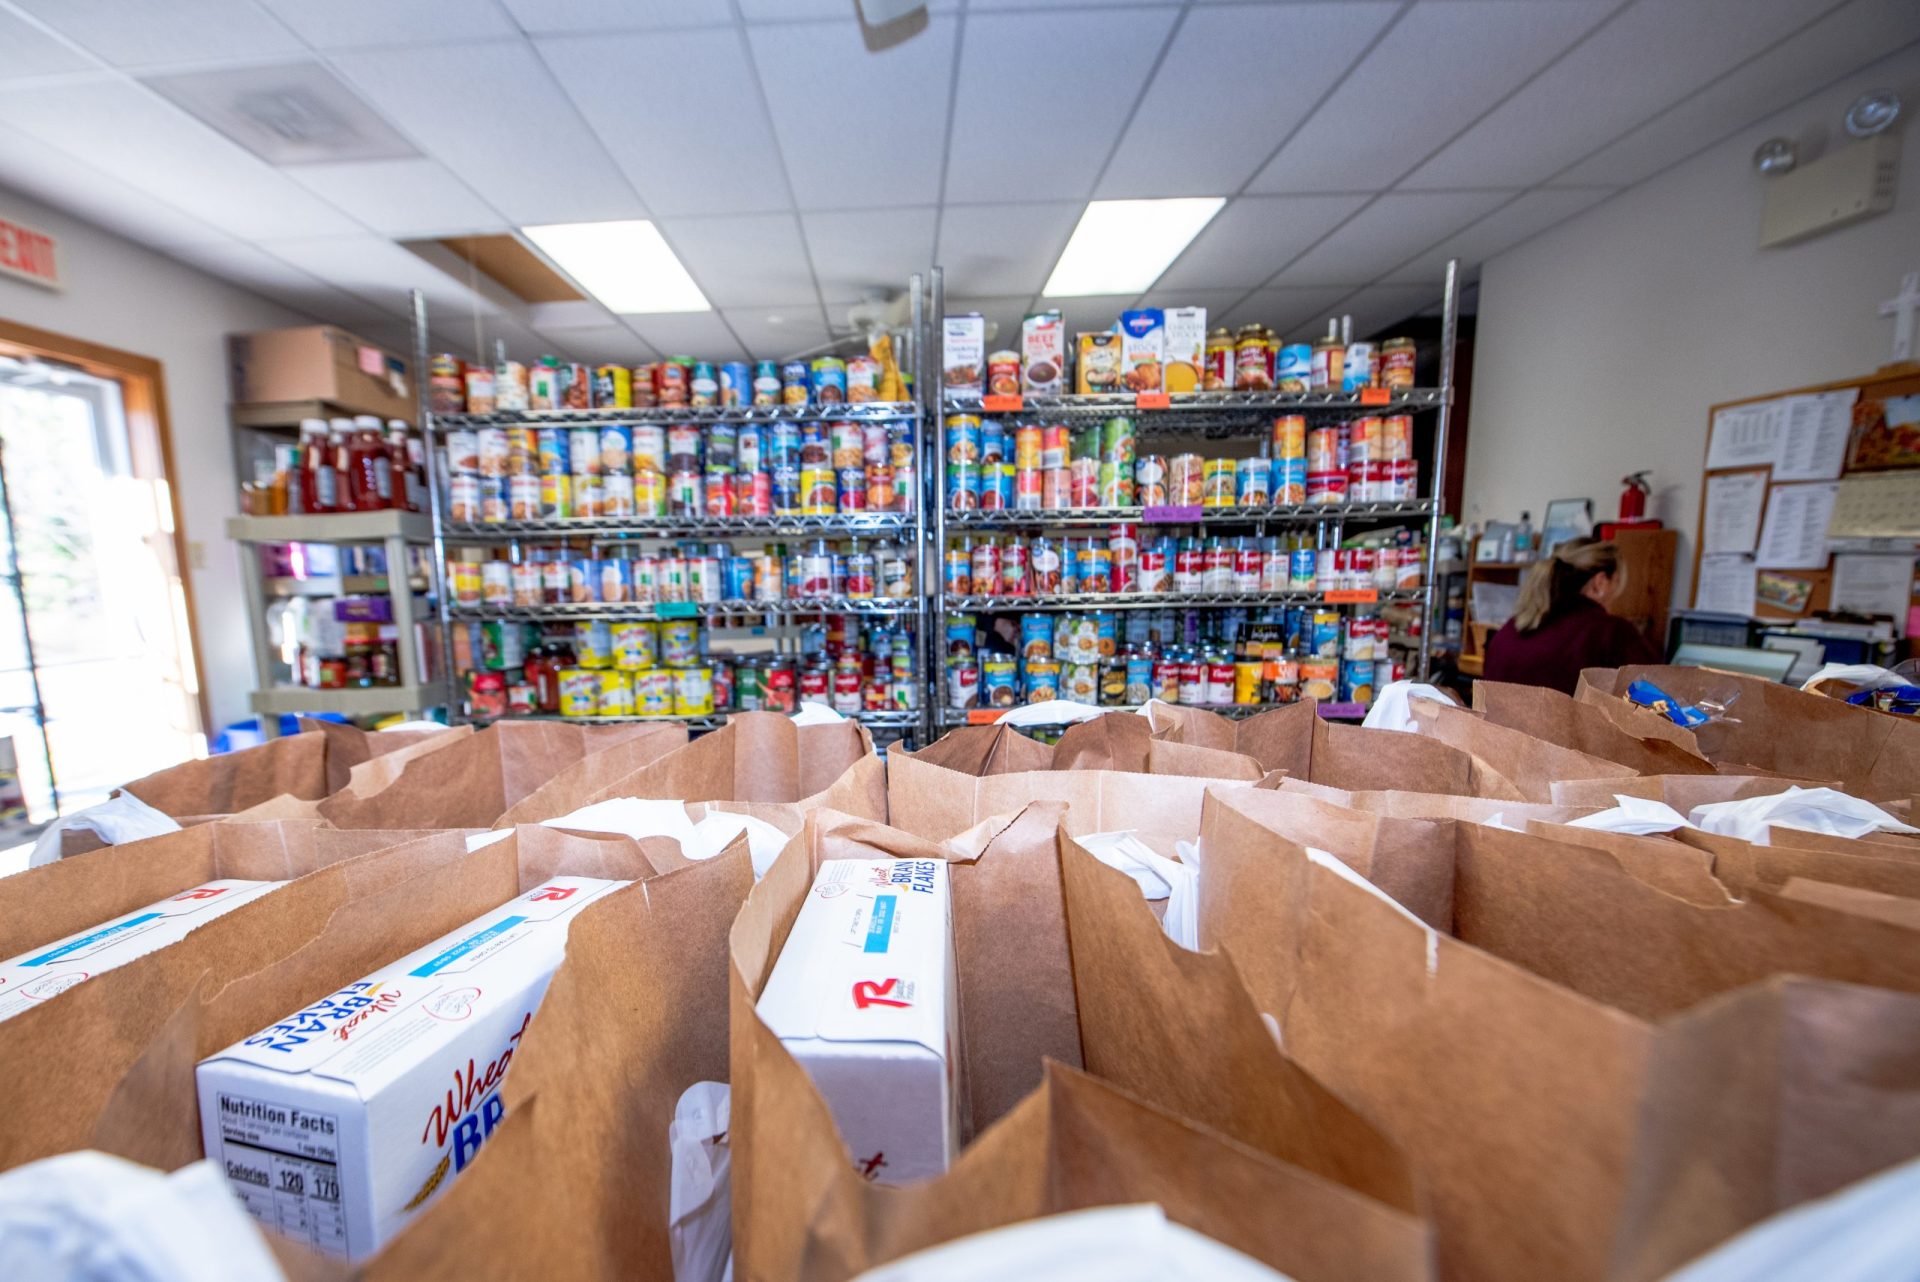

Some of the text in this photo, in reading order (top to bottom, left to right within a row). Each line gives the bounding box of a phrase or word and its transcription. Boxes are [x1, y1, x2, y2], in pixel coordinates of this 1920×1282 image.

[891, 862, 914, 883] BRAN
[913, 861, 936, 894] FLAKES
[244, 983, 373, 1047] FLAKES
[269, 996, 374, 1053] BRAN
[333, 991, 401, 1040] Wheat
[422, 1012, 532, 1148] Wheat
[221, 1097, 335, 1135] Nutrition Facts
[222, 1125, 246, 1139] Serving
[247, 1131, 260, 1142] size
[227, 1160, 270, 1183] Calories
[280, 1169, 304, 1193] 120
[314, 1178, 340, 1201] 170
